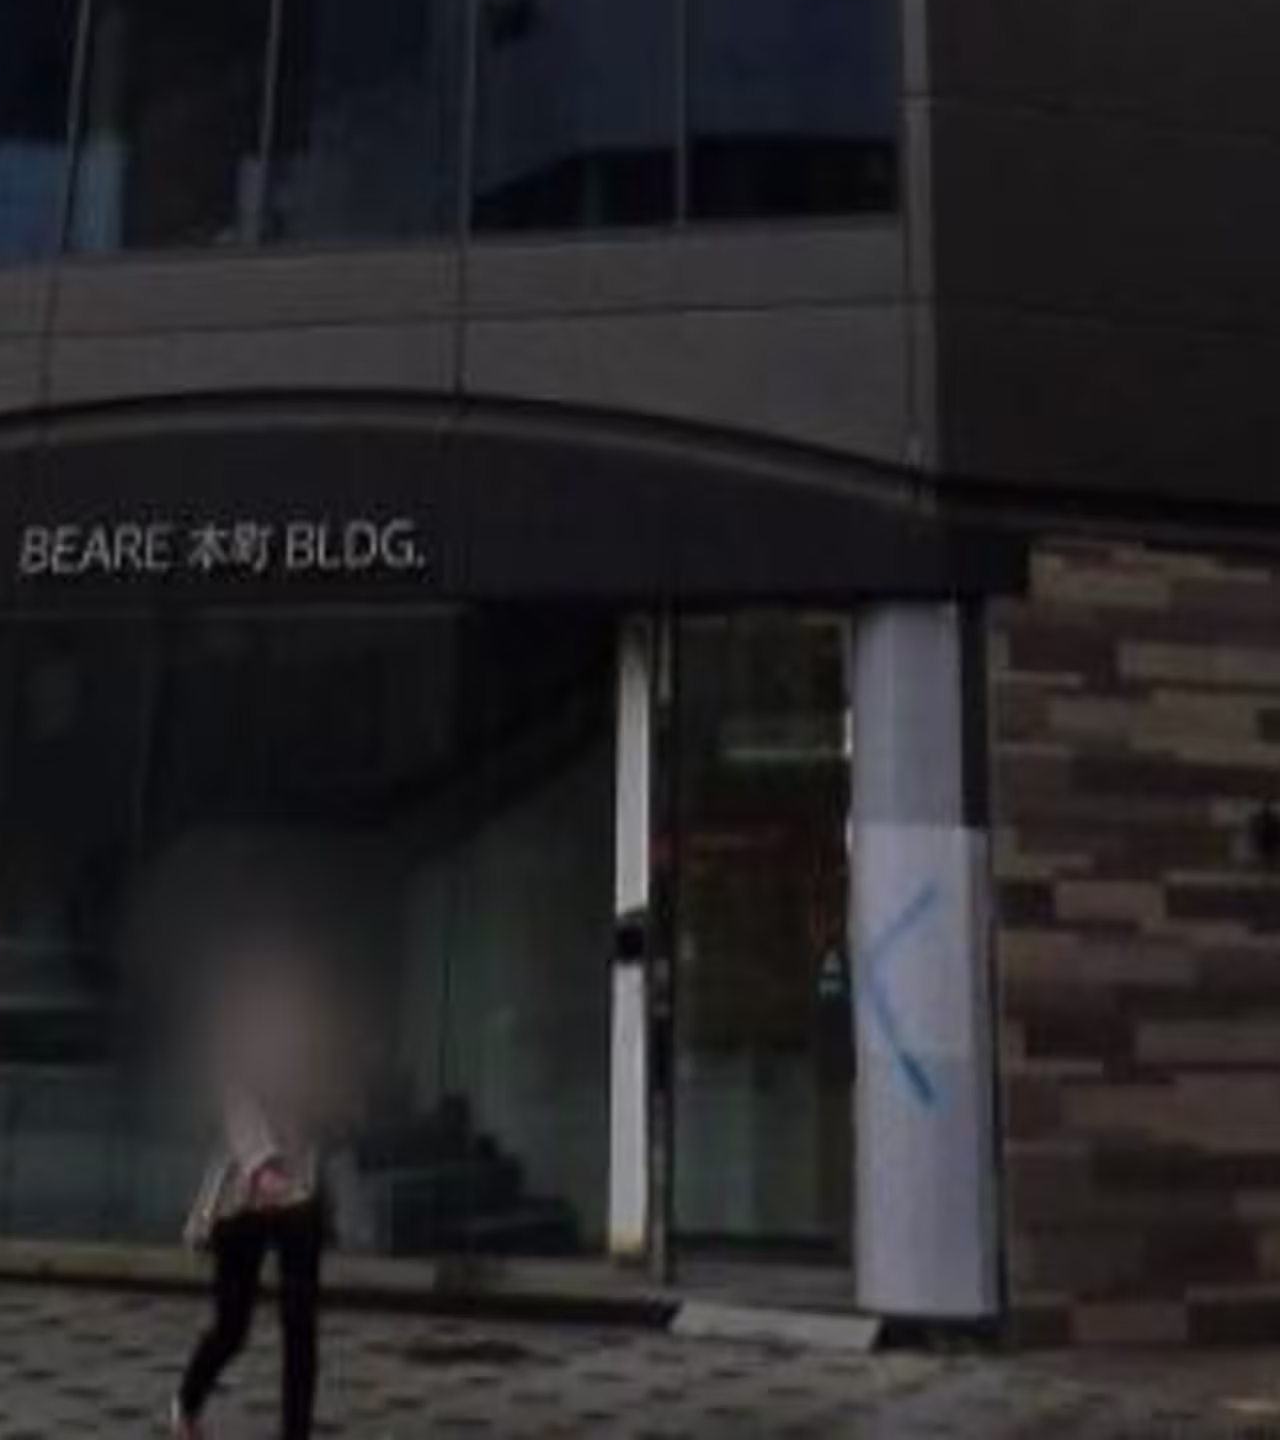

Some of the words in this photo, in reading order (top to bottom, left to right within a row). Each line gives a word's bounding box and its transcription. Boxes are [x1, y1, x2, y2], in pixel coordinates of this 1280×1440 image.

[21, 523, 169, 574] BEARE
[189, 521, 272, 571] 本町
[285, 518, 424, 570] BLDG.
